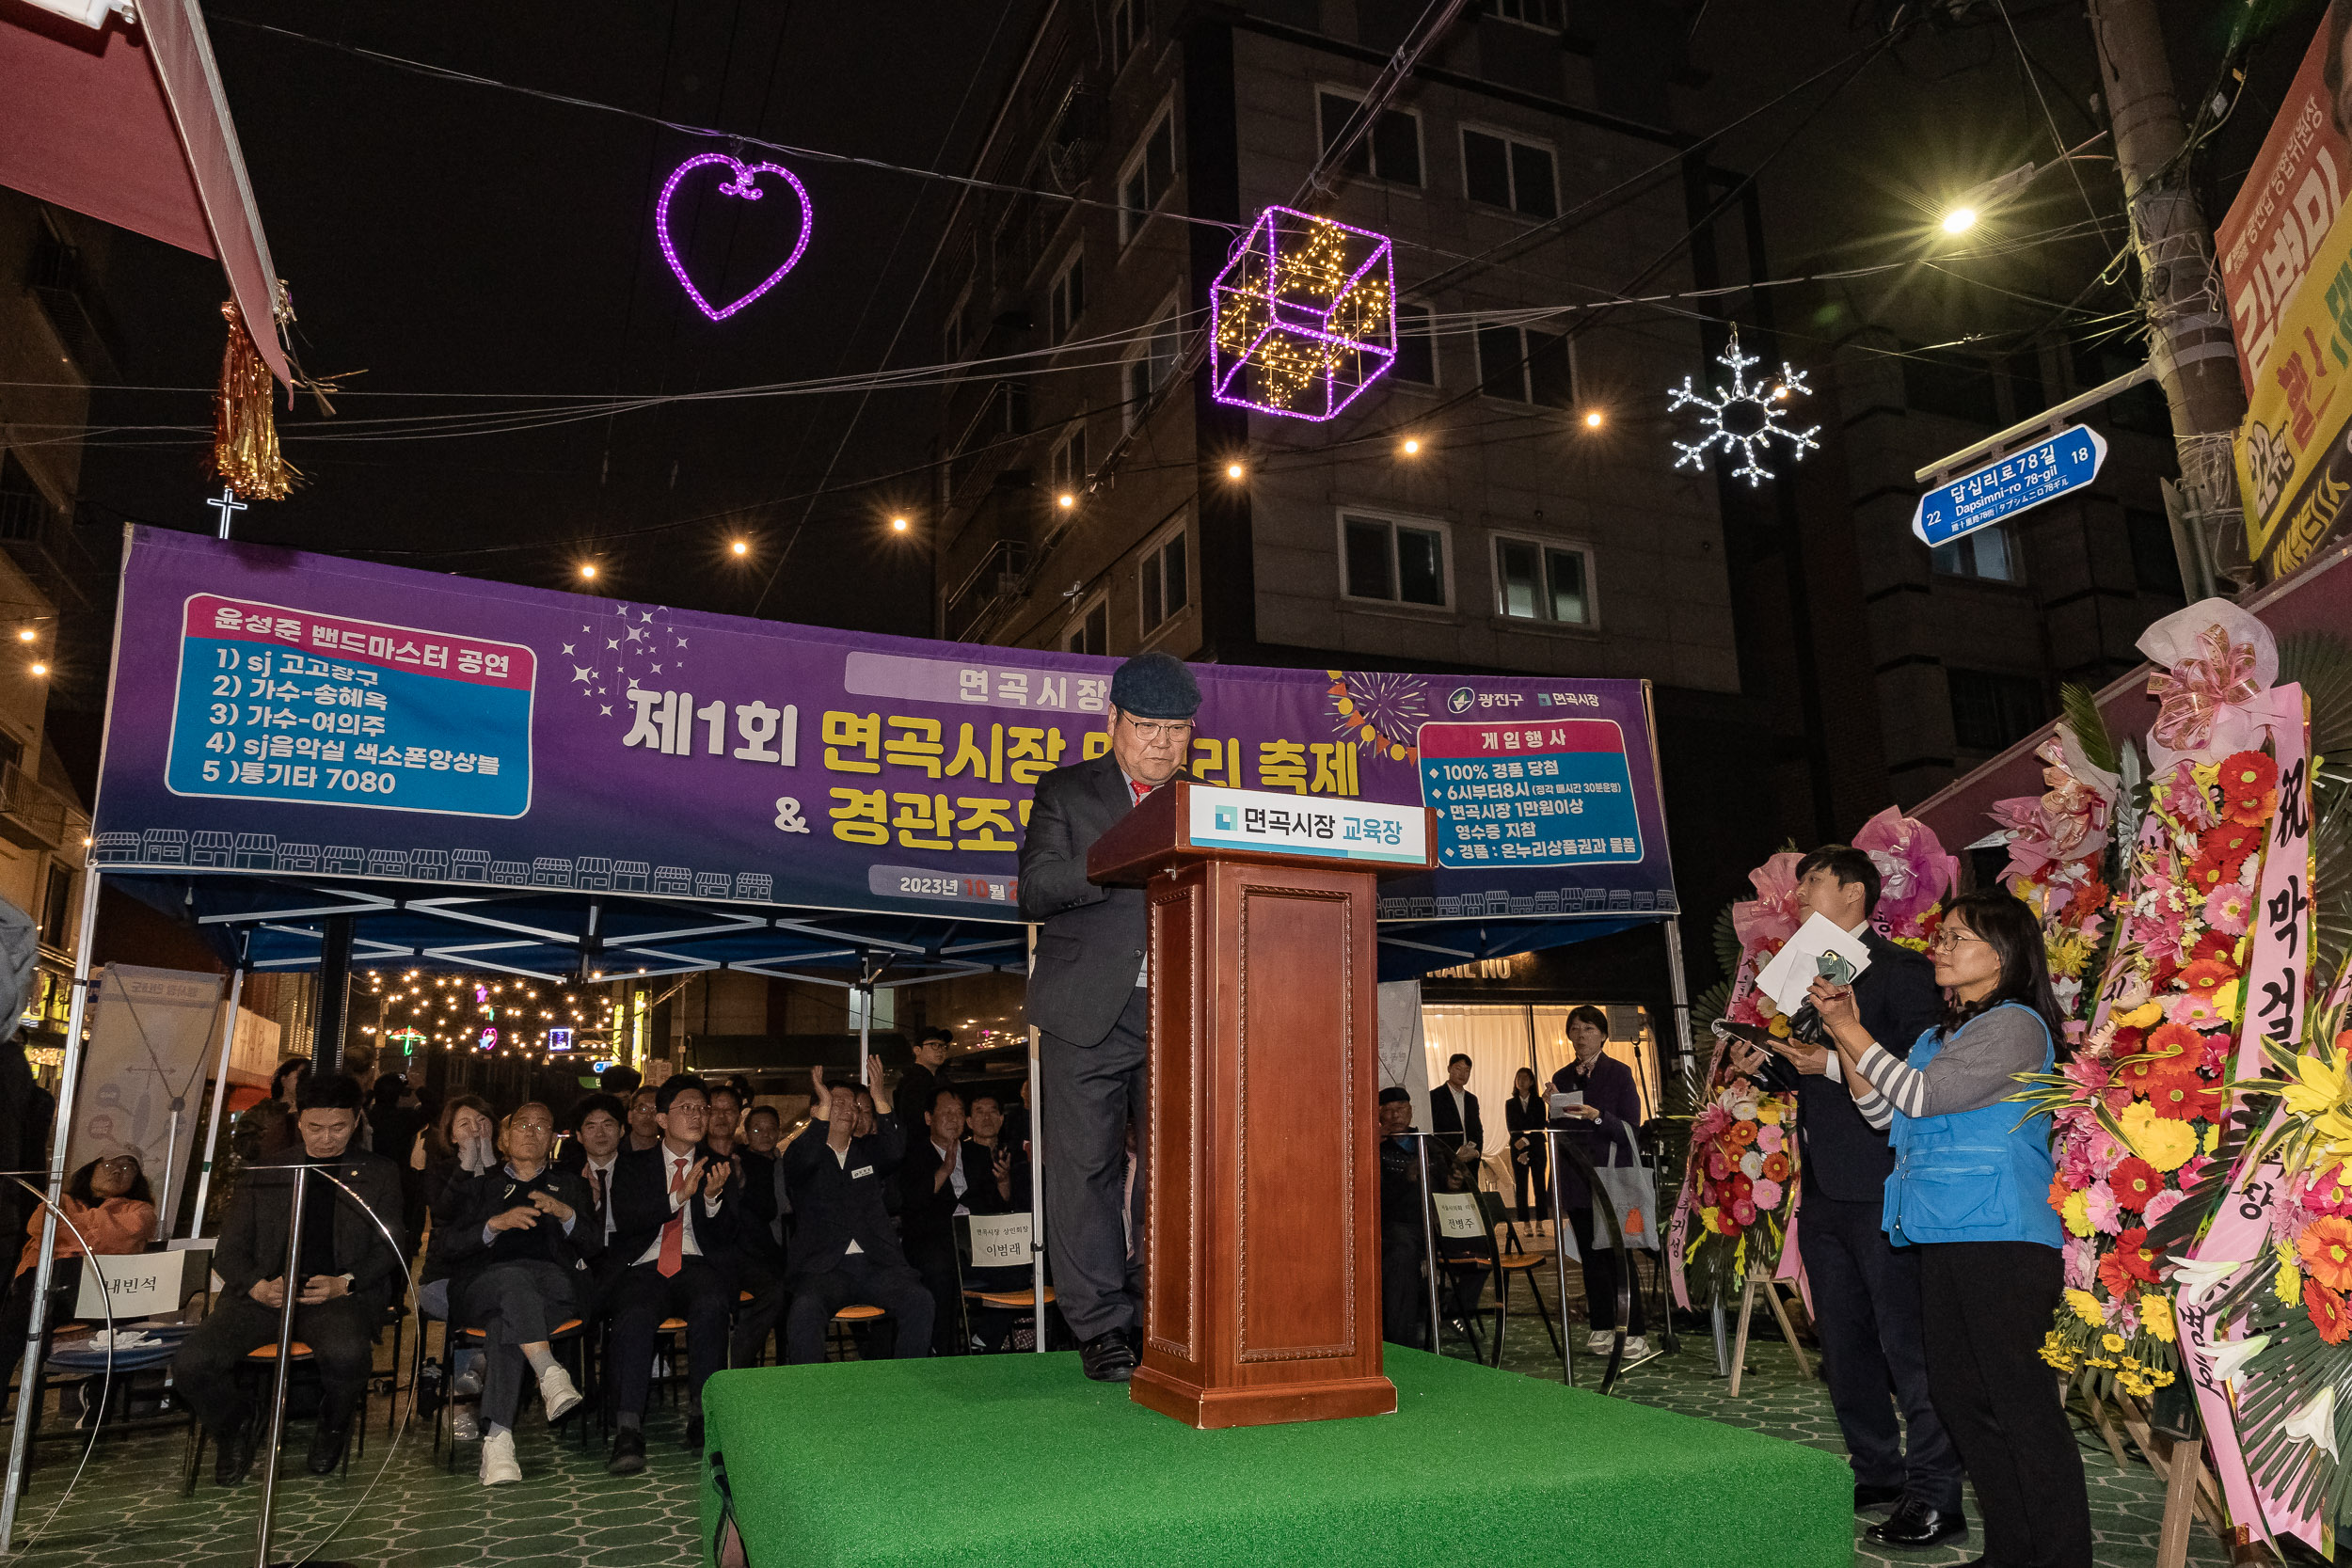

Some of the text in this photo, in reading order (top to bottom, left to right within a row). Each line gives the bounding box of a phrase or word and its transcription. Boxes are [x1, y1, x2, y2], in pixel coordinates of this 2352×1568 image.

[2071, 447, 2089, 465] 18
[1950, 444, 2057, 503] 답십리로78길
[1955, 464, 2058, 517] Dapsimni-ro 78-gil
[1926, 510, 1942, 527] 22
[215, 608, 510, 678] 윤성준 밴드마스터 공연
[216, 648, 378, 687] 1) sj 고고장구
[212, 674, 242, 698] 2)
[1478, 693, 1524, 707] 광진구
[1552, 692, 1600, 707] 면곡시장
[209, 704, 386, 737] 3) 가수-여의주
[205, 731, 500, 776] 4) sj음악실 색소폰앙상블
[622, 689, 798, 767] 제1회
[821, 710, 1066, 784] 면곡시장
[1258, 738, 1360, 796] 축제
[201, 760, 220, 782] 5
[326, 768, 396, 794] 7080
[1443, 760, 1559, 780] 100% 경품 당첨
[1447, 782, 1530, 800] 6시부터8시
[774, 786, 1033, 851] & 경관조
[1450, 799, 1583, 820] 면곡시장 1만원이상
[1245, 807, 1403, 845] 면곡시장 교육장
[1454, 821, 1536, 840] 영수증 지참
[1458, 845, 1489, 860] 경품
[1501, 838, 1606, 859] 온누리상품권과
[1610, 837, 1636, 853] 물품
[900, 877, 959, 896] 2023년
[963, 879, 1005, 899] 10월
[986, 1243, 1021, 1258] 이범래
